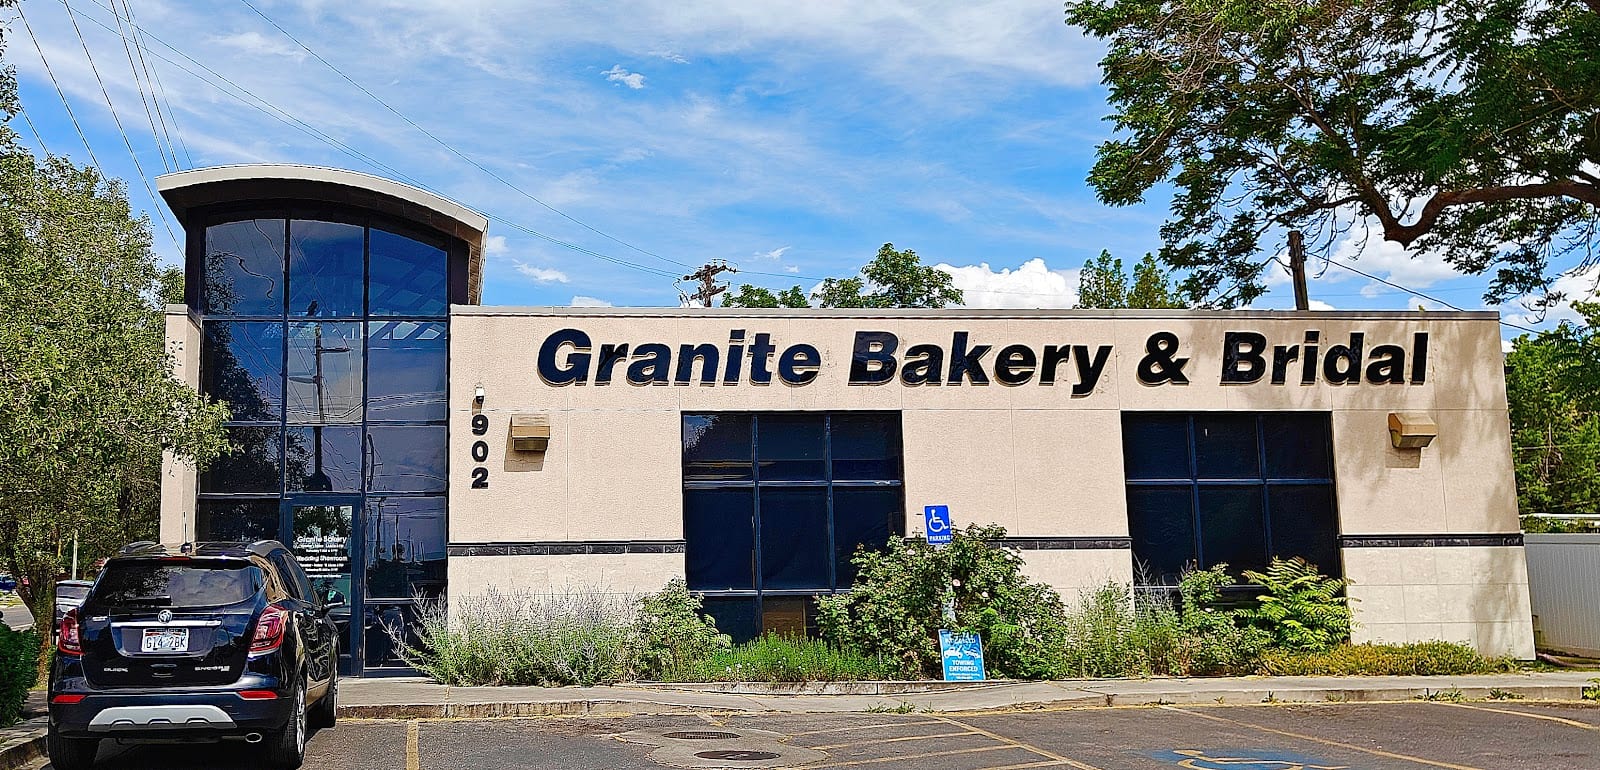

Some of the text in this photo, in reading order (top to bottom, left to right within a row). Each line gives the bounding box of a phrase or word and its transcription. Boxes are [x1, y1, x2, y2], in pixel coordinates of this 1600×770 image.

[537, 328, 1428, 398] Granite Bakery & Bridal
[471, 414, 489, 490] 902
